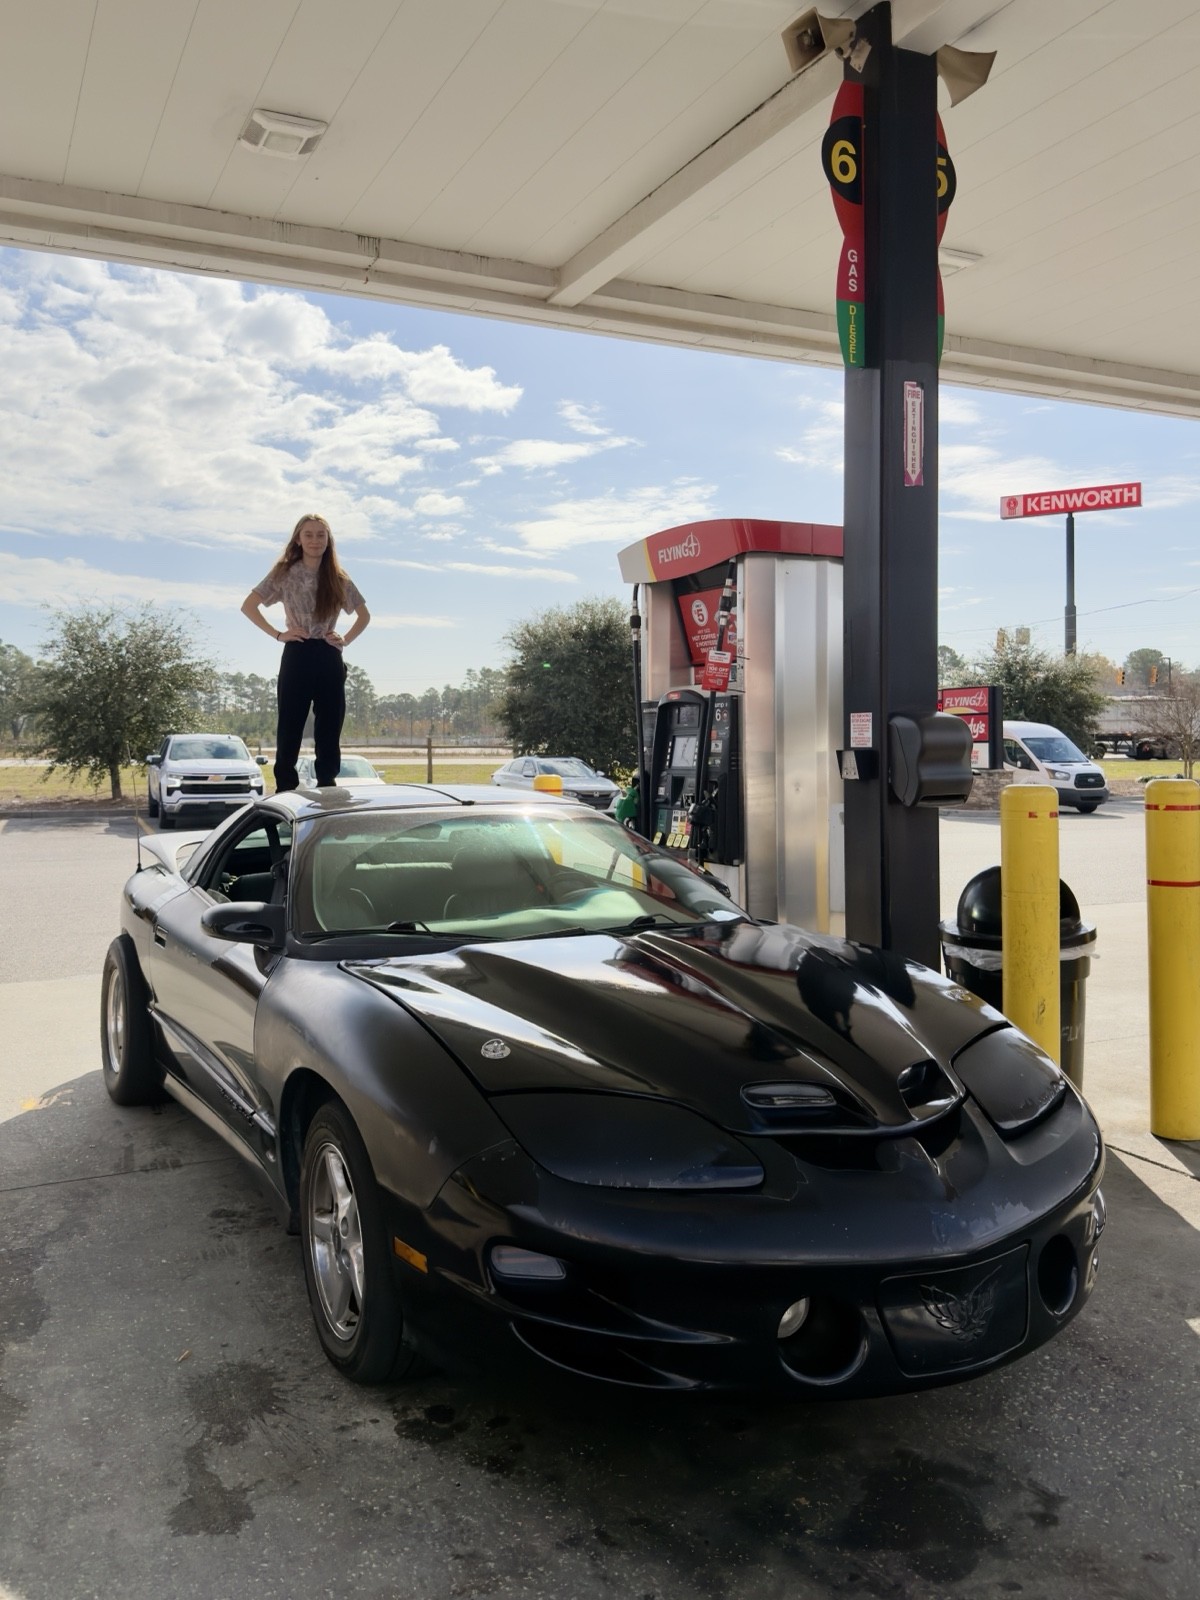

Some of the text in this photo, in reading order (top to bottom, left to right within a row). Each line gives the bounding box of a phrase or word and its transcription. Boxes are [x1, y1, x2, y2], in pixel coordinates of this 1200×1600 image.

[831, 140, 857, 184] 6
[847, 249, 858, 292] GAS
[849, 305, 857, 363] DIESEL
[907, 389, 921, 399] FIRE
[1027, 487, 1137, 512] KENWORTH
[658, 542, 688, 564] FLYING
[945, 696, 977, 707] FLYING
[715, 708, 721, 721] 6
